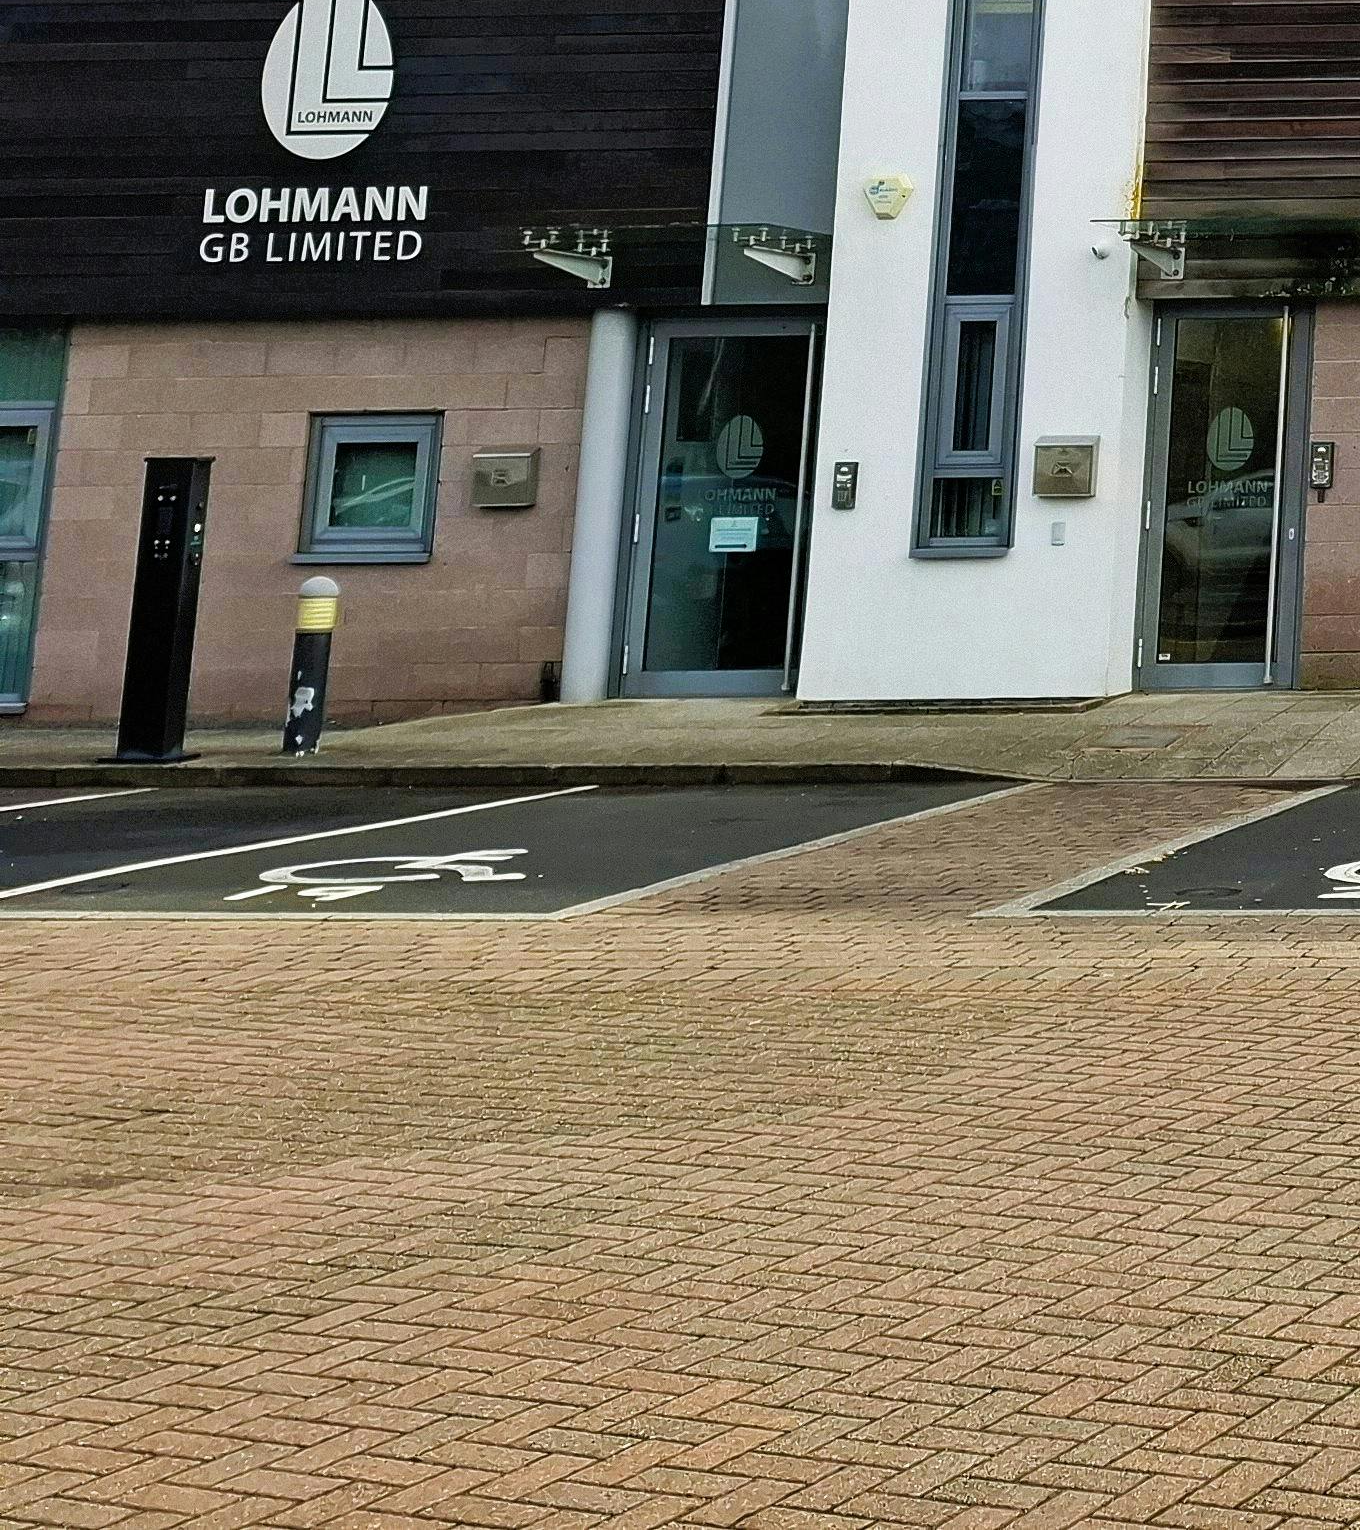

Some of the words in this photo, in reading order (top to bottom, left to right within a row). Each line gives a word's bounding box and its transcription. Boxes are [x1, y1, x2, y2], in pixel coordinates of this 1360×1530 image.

[297, 110, 373, 124] LOHMANN
[202, 185, 428, 224] LOHMANN
[199, 232, 249, 263] GB
[265, 230, 422, 262] LIMITED
[702, 487, 777, 501] OHMANN
[1187, 480, 1269, 494] LOHMANN
